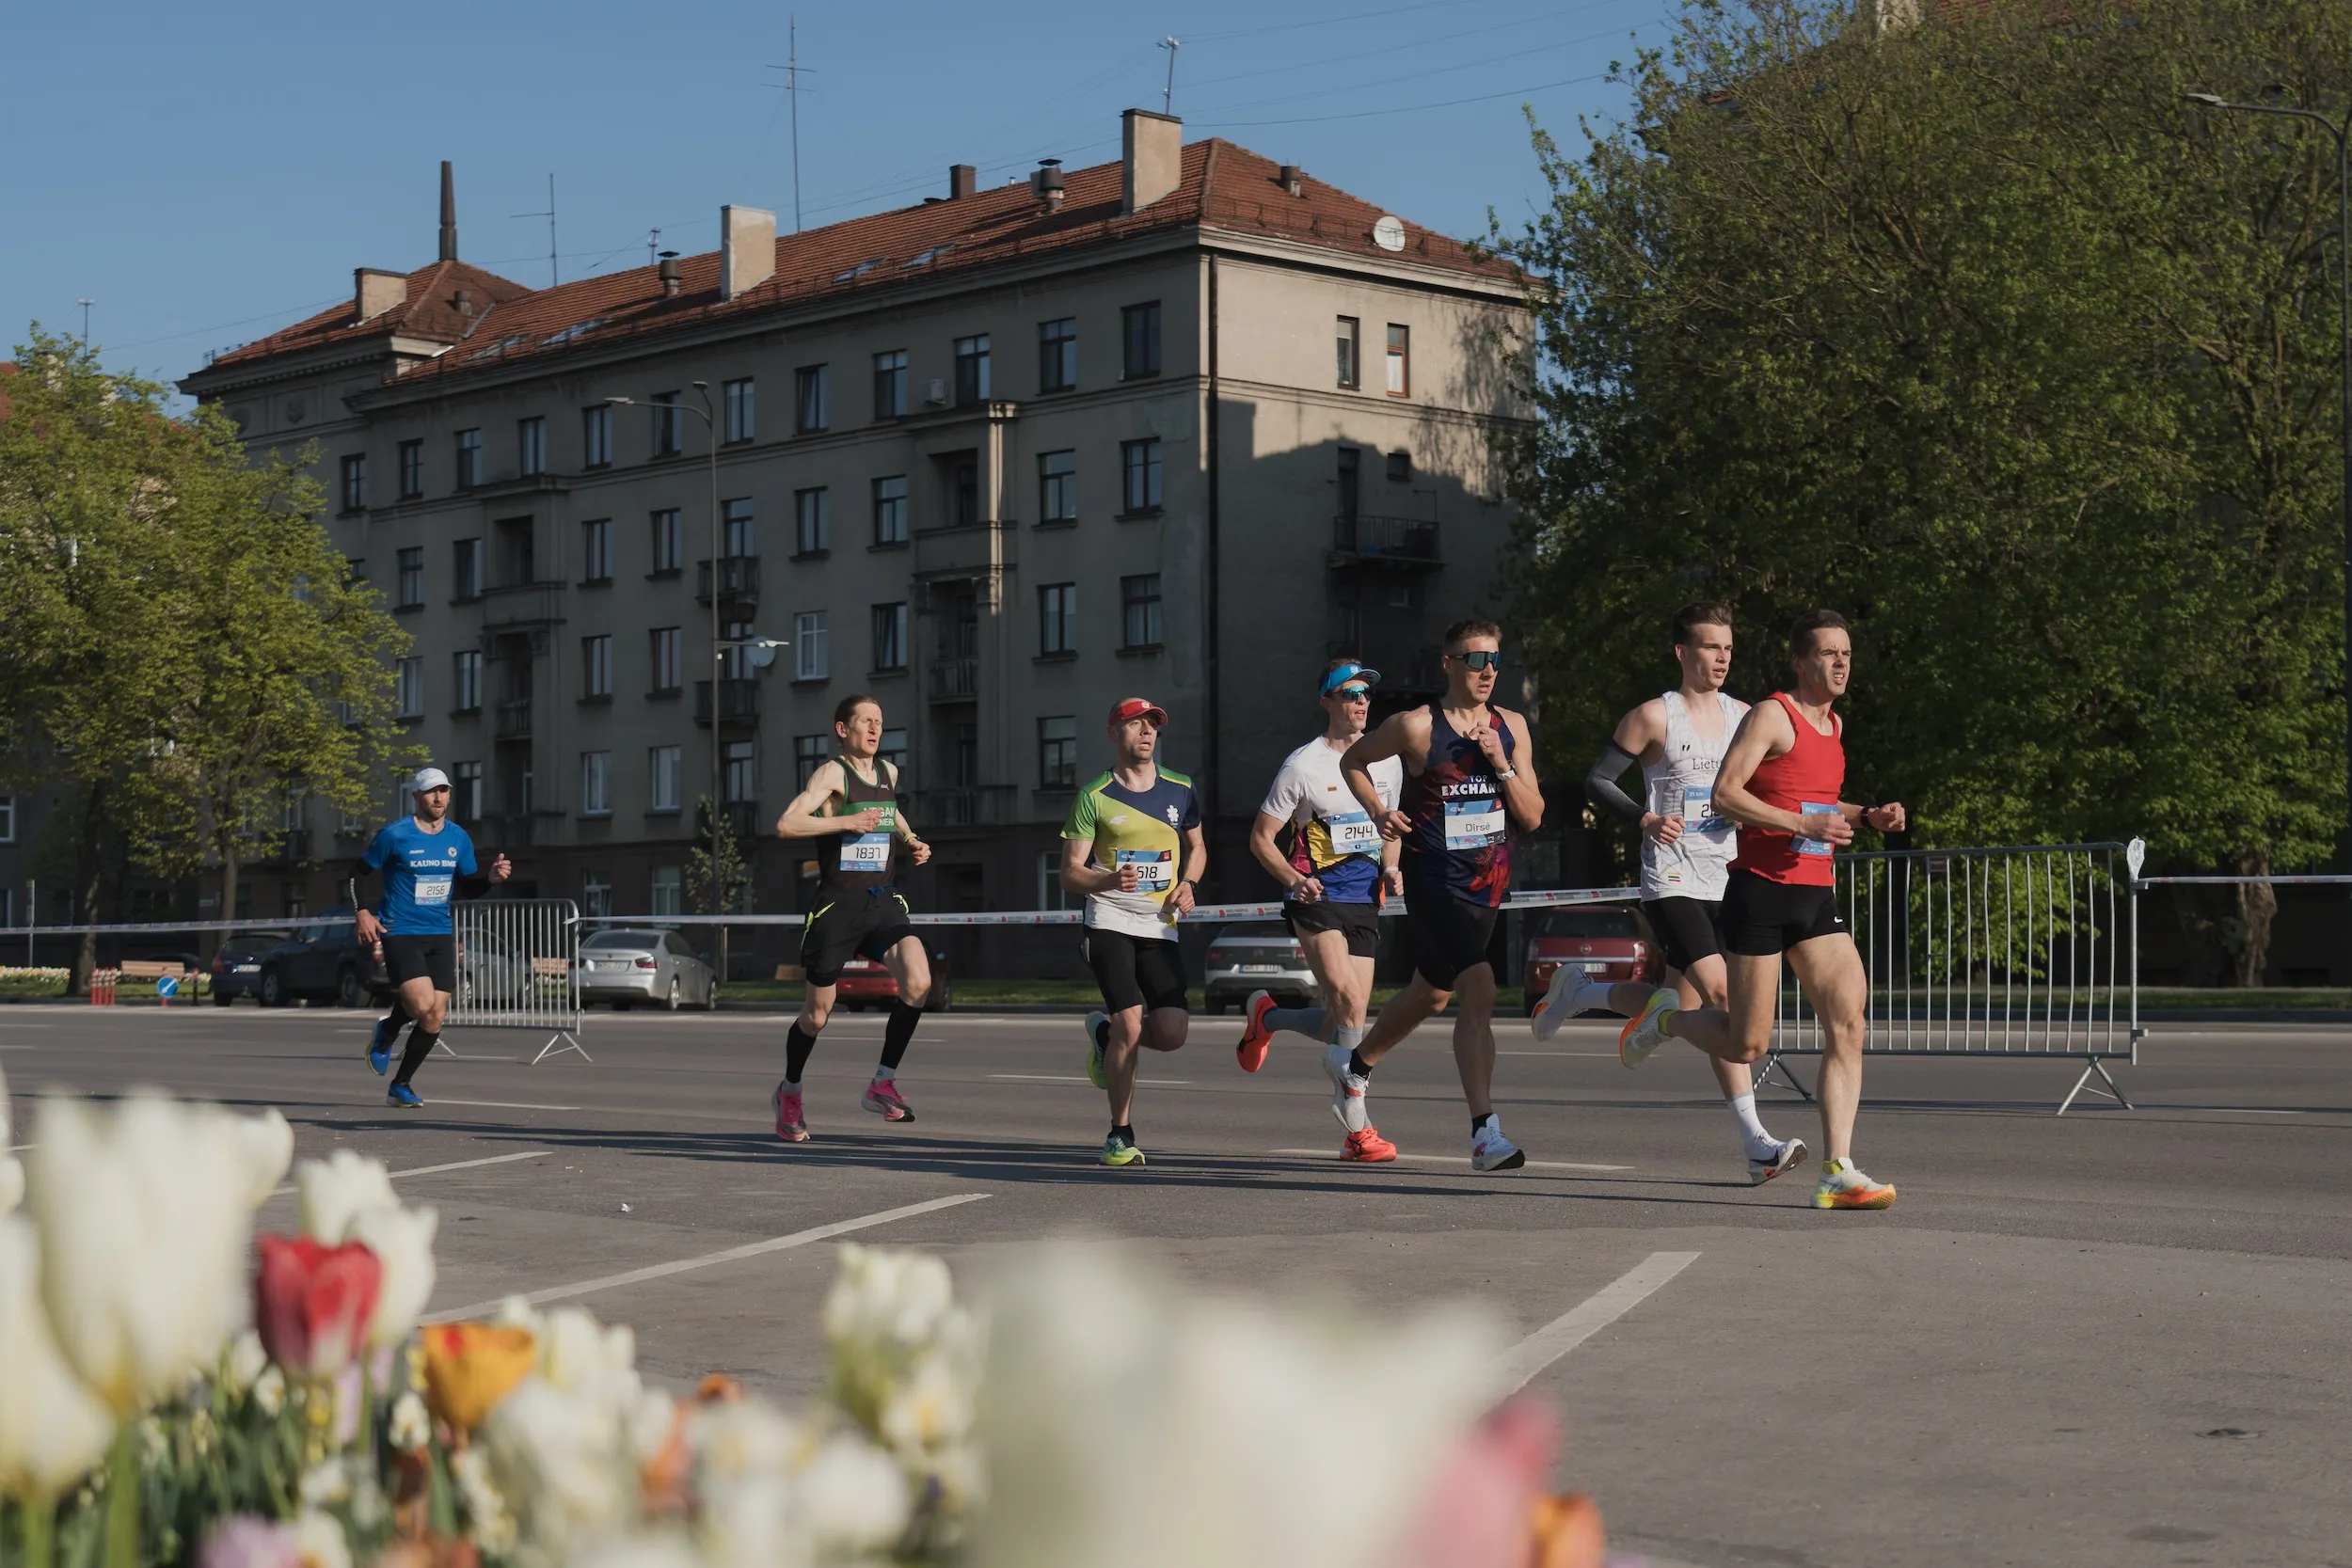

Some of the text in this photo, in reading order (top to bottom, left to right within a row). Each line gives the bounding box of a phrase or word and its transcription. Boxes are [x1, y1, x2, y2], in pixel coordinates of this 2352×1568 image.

[1344, 825, 1373, 839] 2144
[856, 847, 881, 859] 1837
[426, 885, 445, 895] 2156
